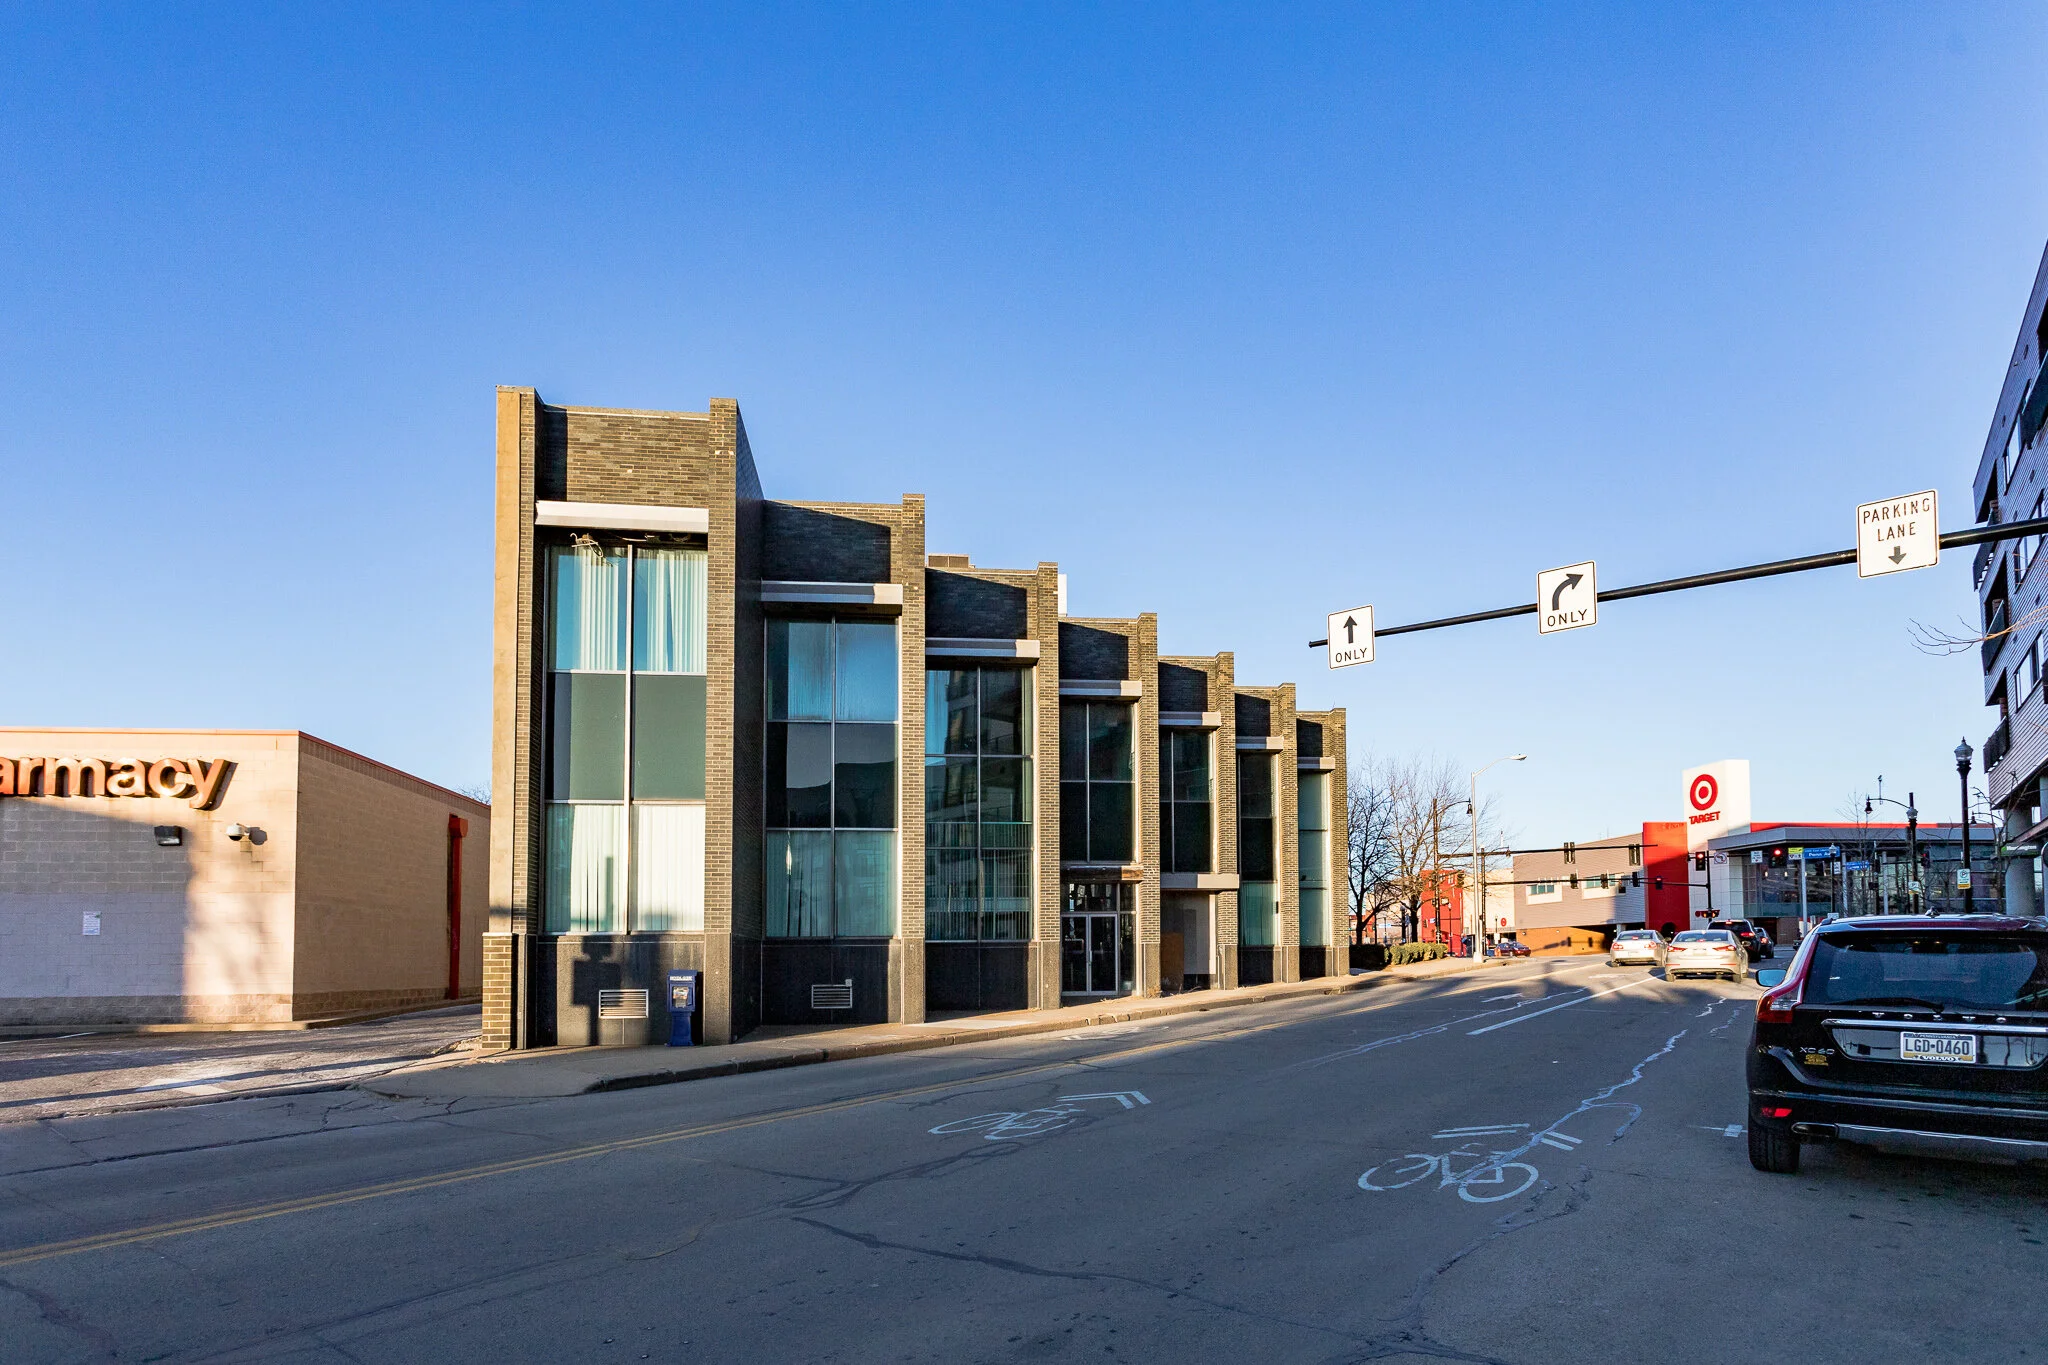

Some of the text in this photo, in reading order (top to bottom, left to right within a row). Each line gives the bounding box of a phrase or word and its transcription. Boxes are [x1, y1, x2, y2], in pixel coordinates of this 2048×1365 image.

[1863, 498, 1930, 524] PARKING
[1878, 522, 1916, 541] LANE
[1547, 609, 1588, 627] ONLY
[1335, 648, 1367, 663] ONLY
[1689, 811, 1721, 825] TARGET
